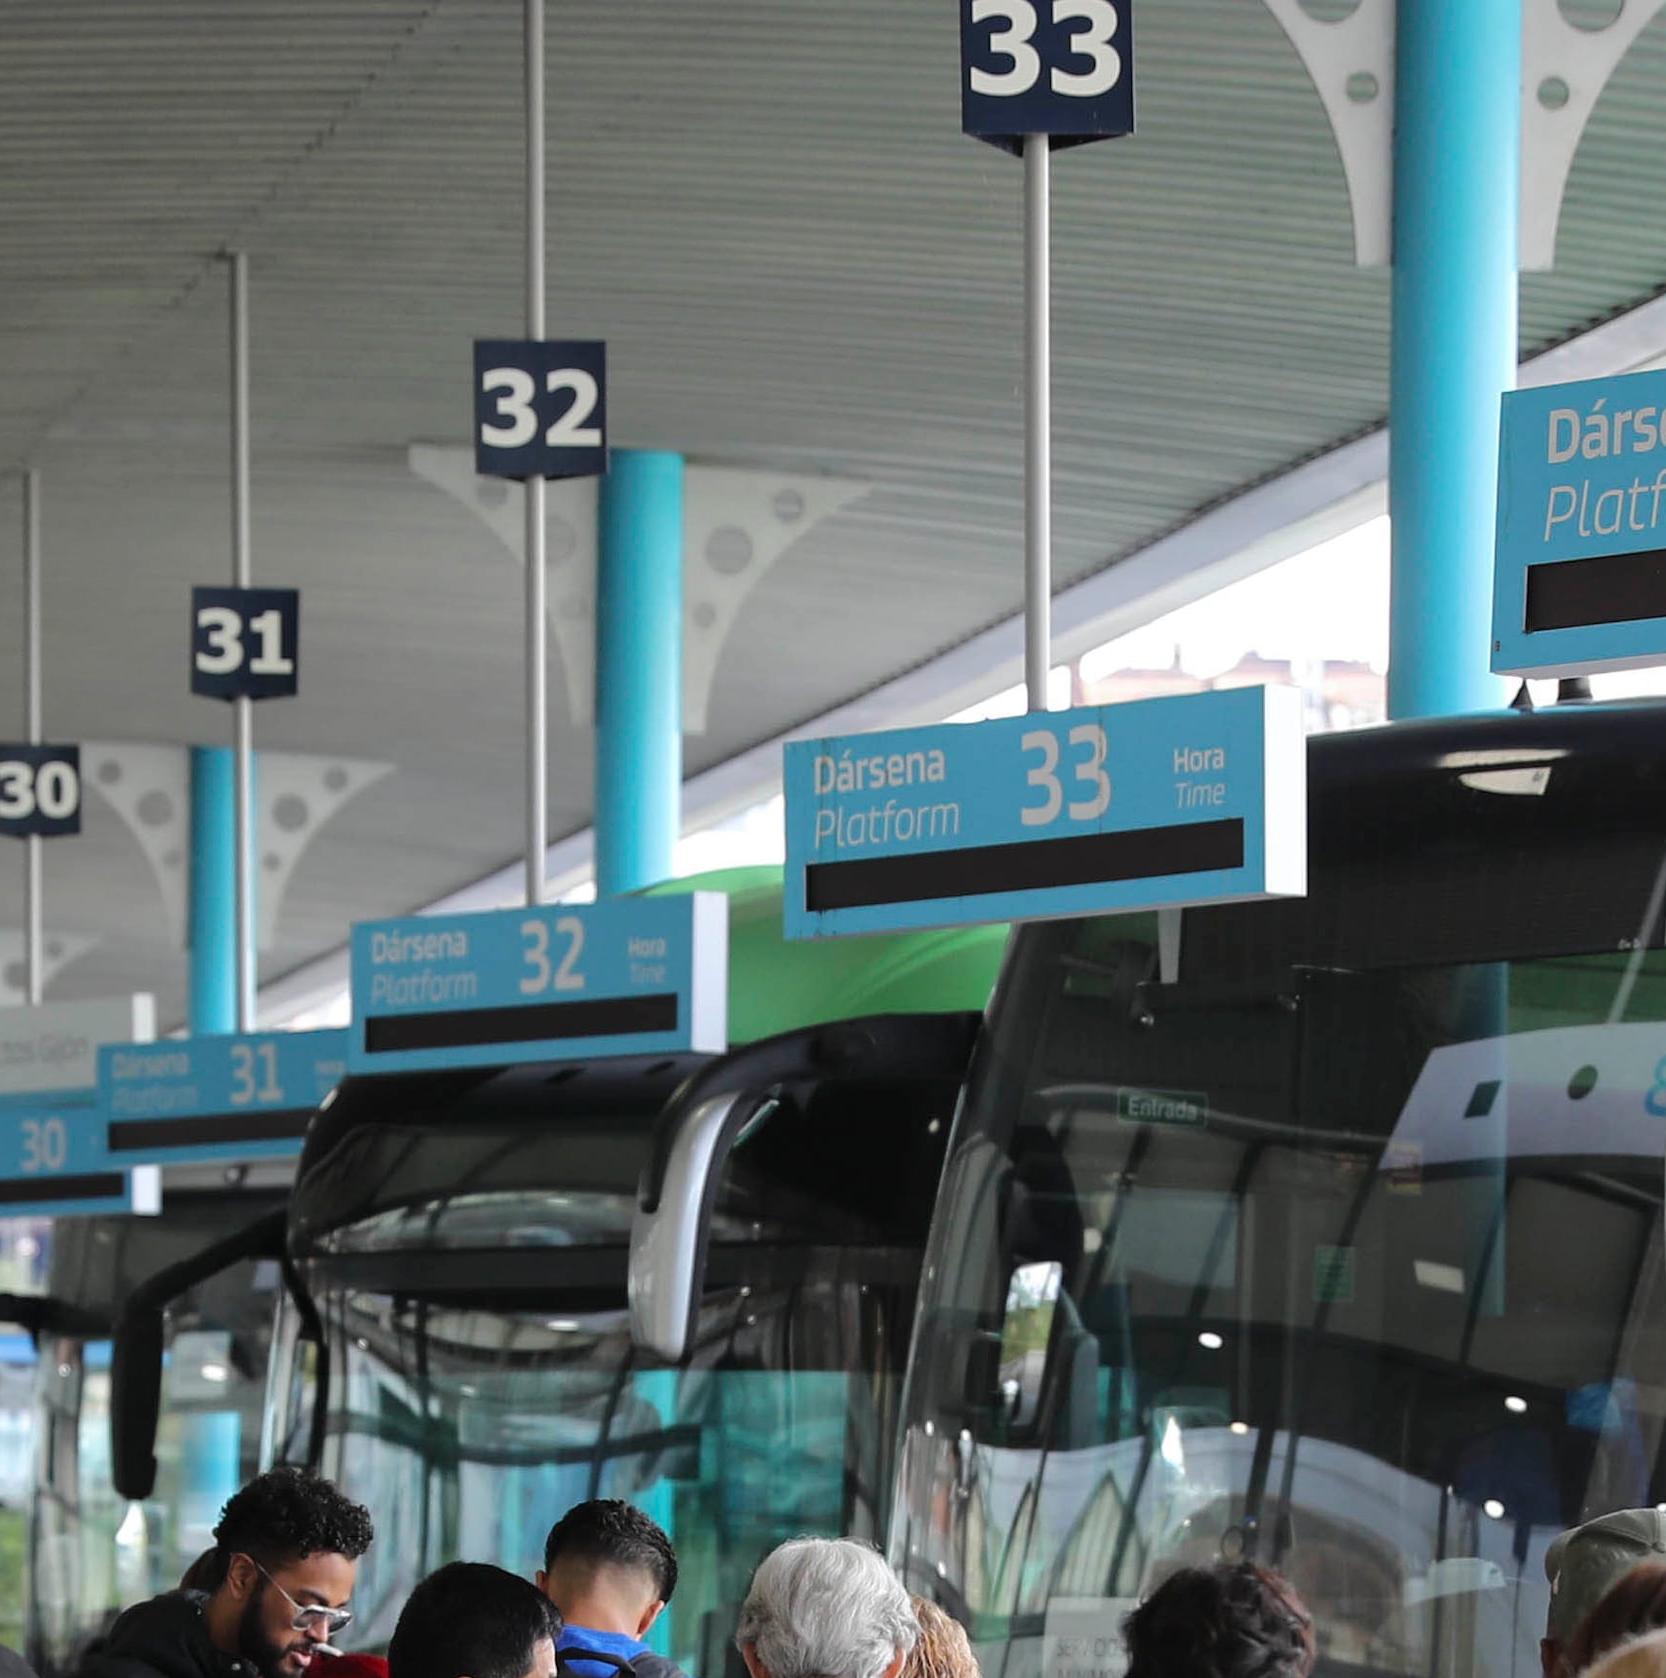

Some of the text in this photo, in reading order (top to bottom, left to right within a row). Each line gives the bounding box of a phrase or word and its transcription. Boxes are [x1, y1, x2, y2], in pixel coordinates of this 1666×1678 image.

[968, 0, 1123, 98] 33
[479, 367, 603, 449] 32
[194, 607, 293, 675] 31
[814, 723, 1225, 827] Dársena 33 Hora
[814, 780, 1225, 850] Platform Time
[371, 917, 667, 994] Dársena 32 Hora
[371, 968, 478, 1006] Platform
[229, 1042, 284, 1105] 31
[1128, 1096, 1198, 1121] Entrada
[20, 1116, 67, 1173] 30
